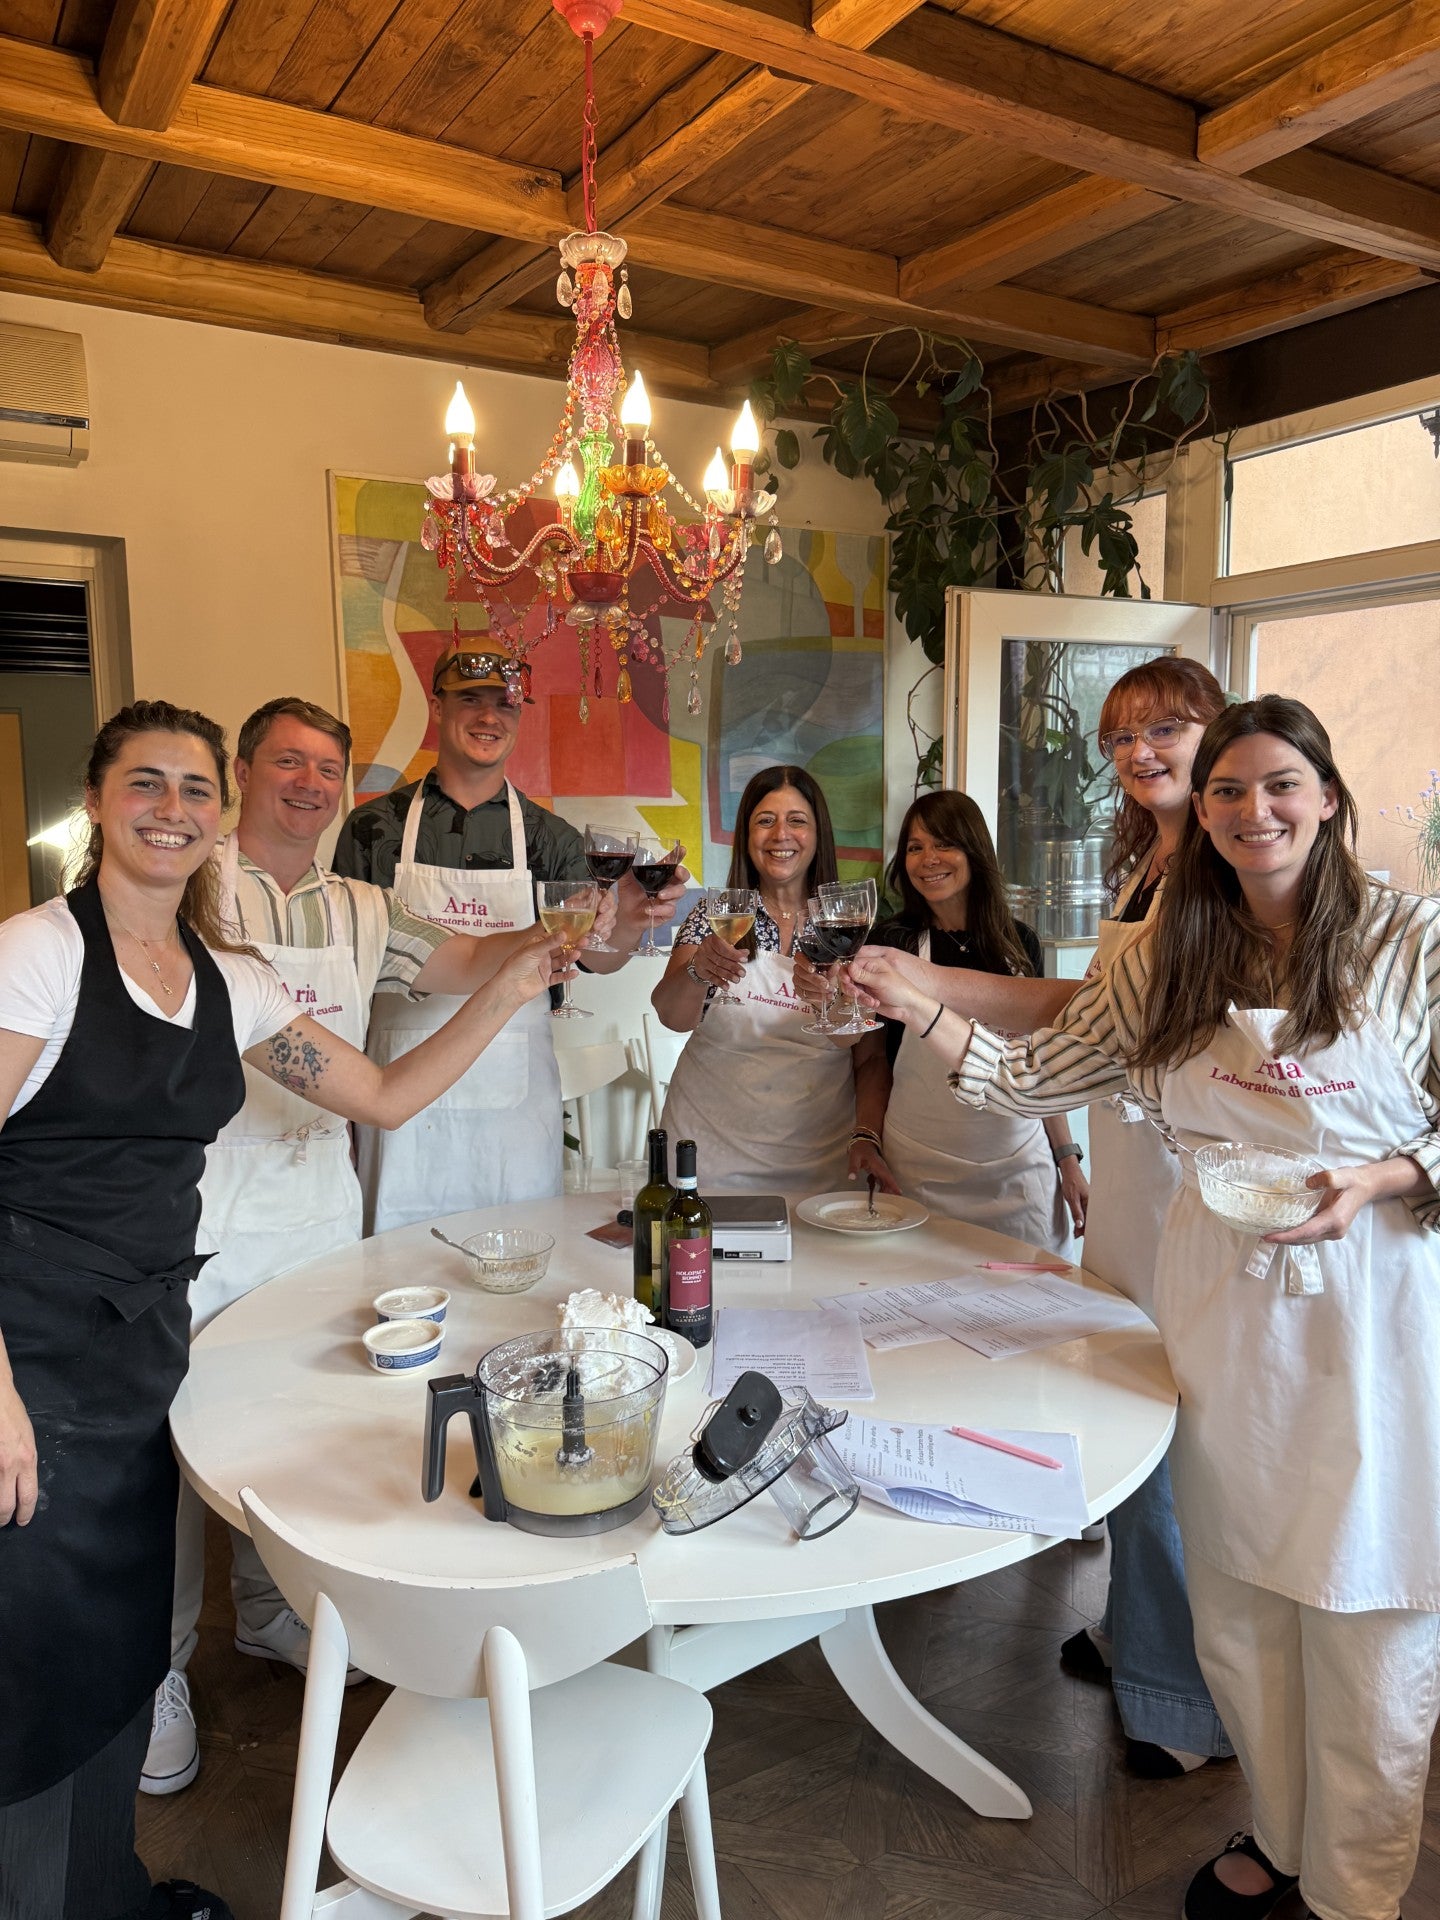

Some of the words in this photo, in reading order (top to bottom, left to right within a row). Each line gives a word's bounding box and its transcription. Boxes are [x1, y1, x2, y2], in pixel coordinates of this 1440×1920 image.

[443, 896, 488, 916] Aria
[473, 917, 482, 928] di
[485, 919, 514, 928] cucina
[305, 1007, 315, 1017] di
[316, 1003, 343, 1016] cucina
[747, 991, 799, 1011] Laboratorio
[801, 1005, 811, 1014] di
[1288, 1085, 1301, 1098] di
[1304, 1080, 1356, 1097] cucina
